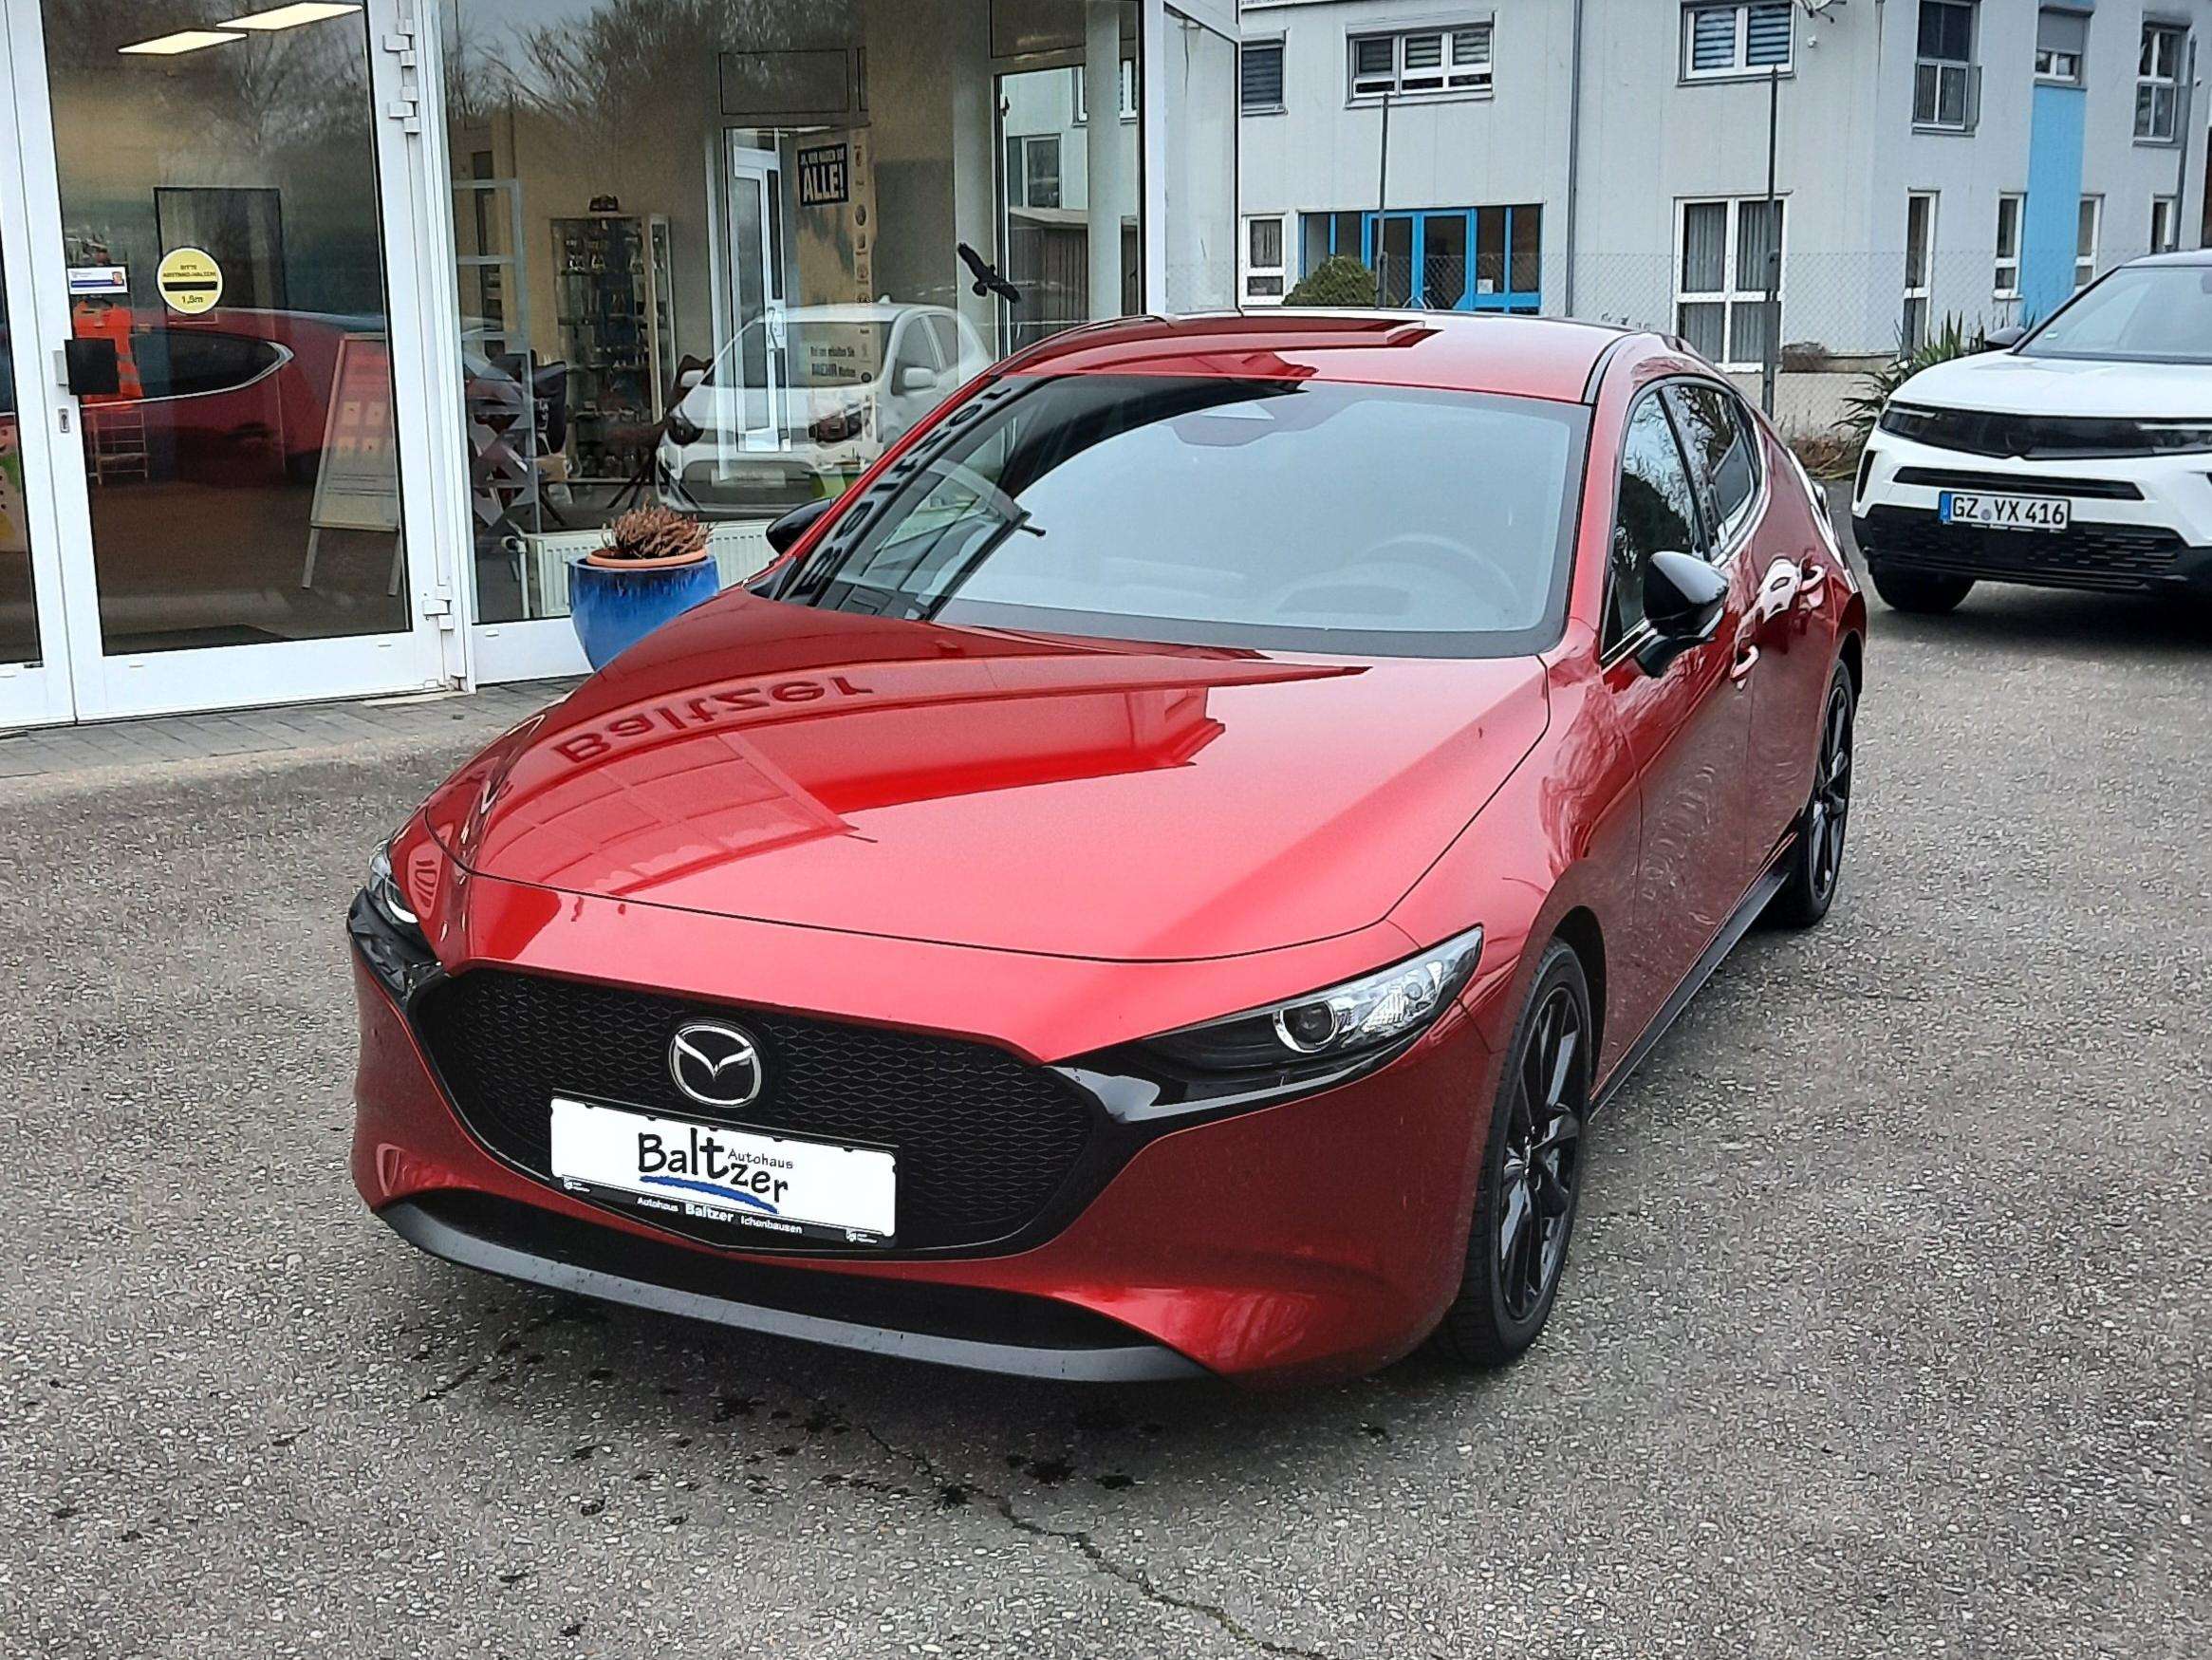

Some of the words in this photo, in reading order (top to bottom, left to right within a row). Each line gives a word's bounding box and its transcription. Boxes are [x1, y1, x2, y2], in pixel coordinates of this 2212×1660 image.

[803, 162, 845, 202] ALLE!
[1953, 496, 1980, 519] GZ
[1994, 499, 2020, 522] YX
[2025, 502, 2065, 525] 416
[638, 1127, 790, 1203] Baltzer
[727, 1147, 794, 1169] Autohaus
[636, 1196, 679, 1213] Autohaus
[684, 1202, 734, 1222] Baltzer
[740, 1214, 804, 1235] Ichenhausen
